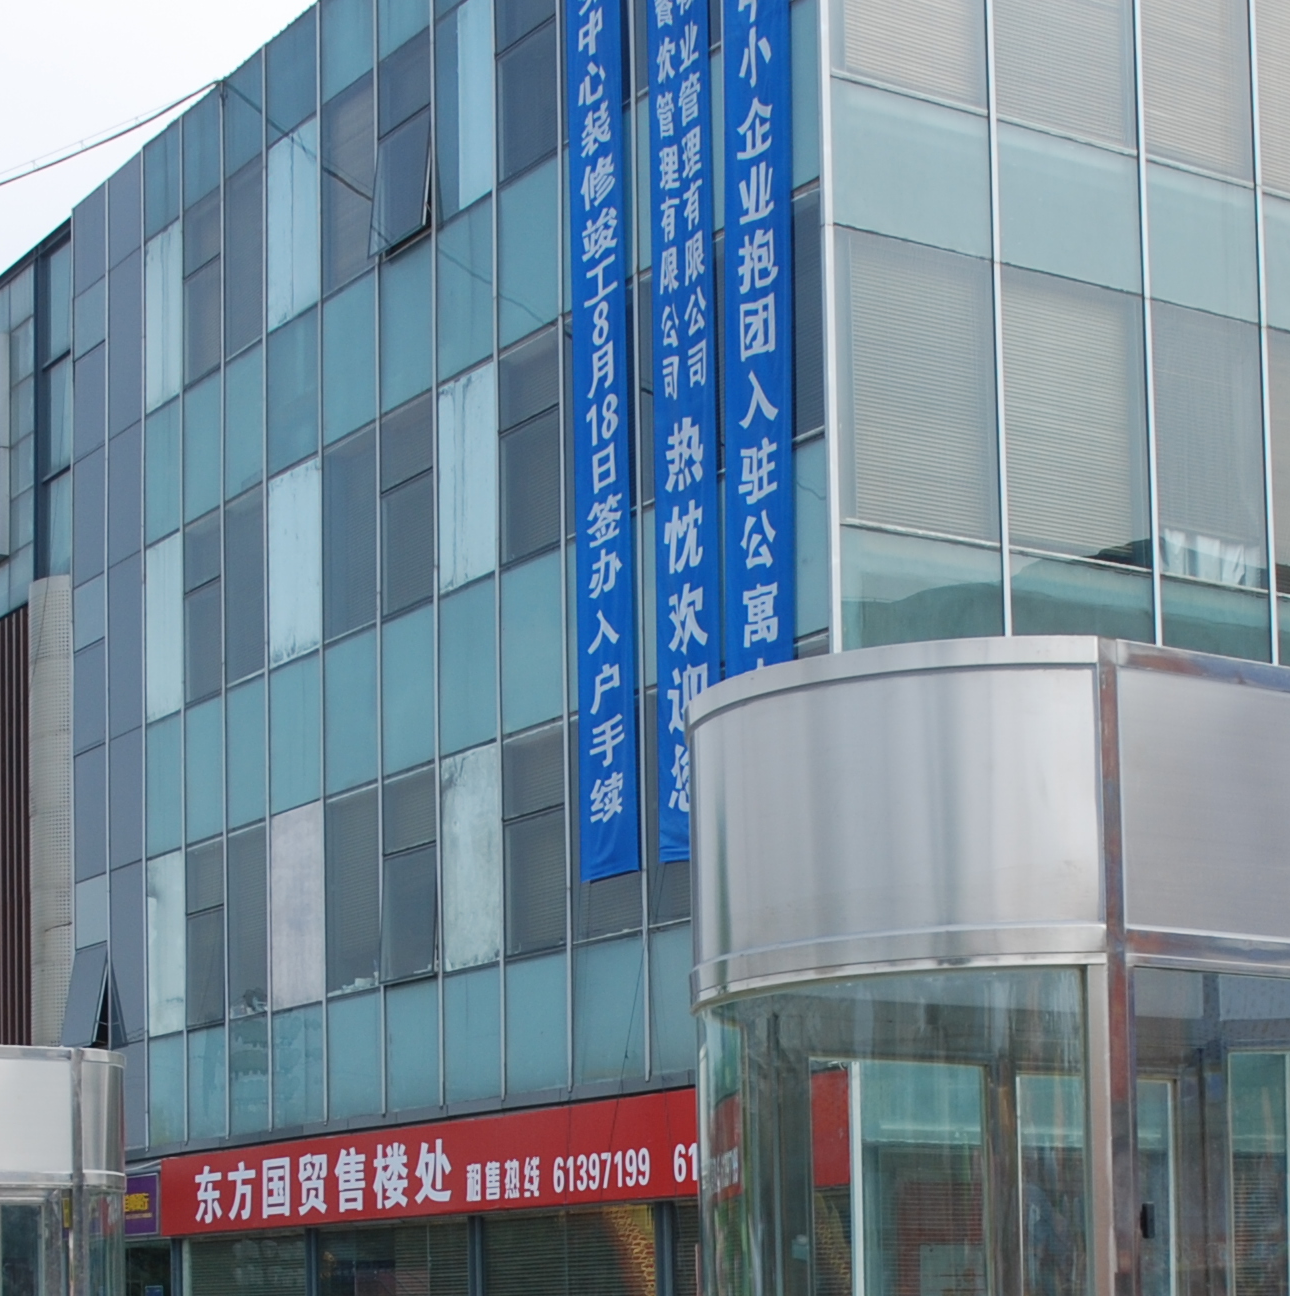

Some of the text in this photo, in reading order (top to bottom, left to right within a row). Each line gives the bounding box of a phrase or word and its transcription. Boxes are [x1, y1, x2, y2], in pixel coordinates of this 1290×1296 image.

[736, 0, 782, 673] 小企业抱团入驻公寓
[194, 1138, 452, 1225] 东方国贸售楼处
[465, 1156, 541, 1202] 租售热线
[552, 1147, 651, 1193] 61397199
